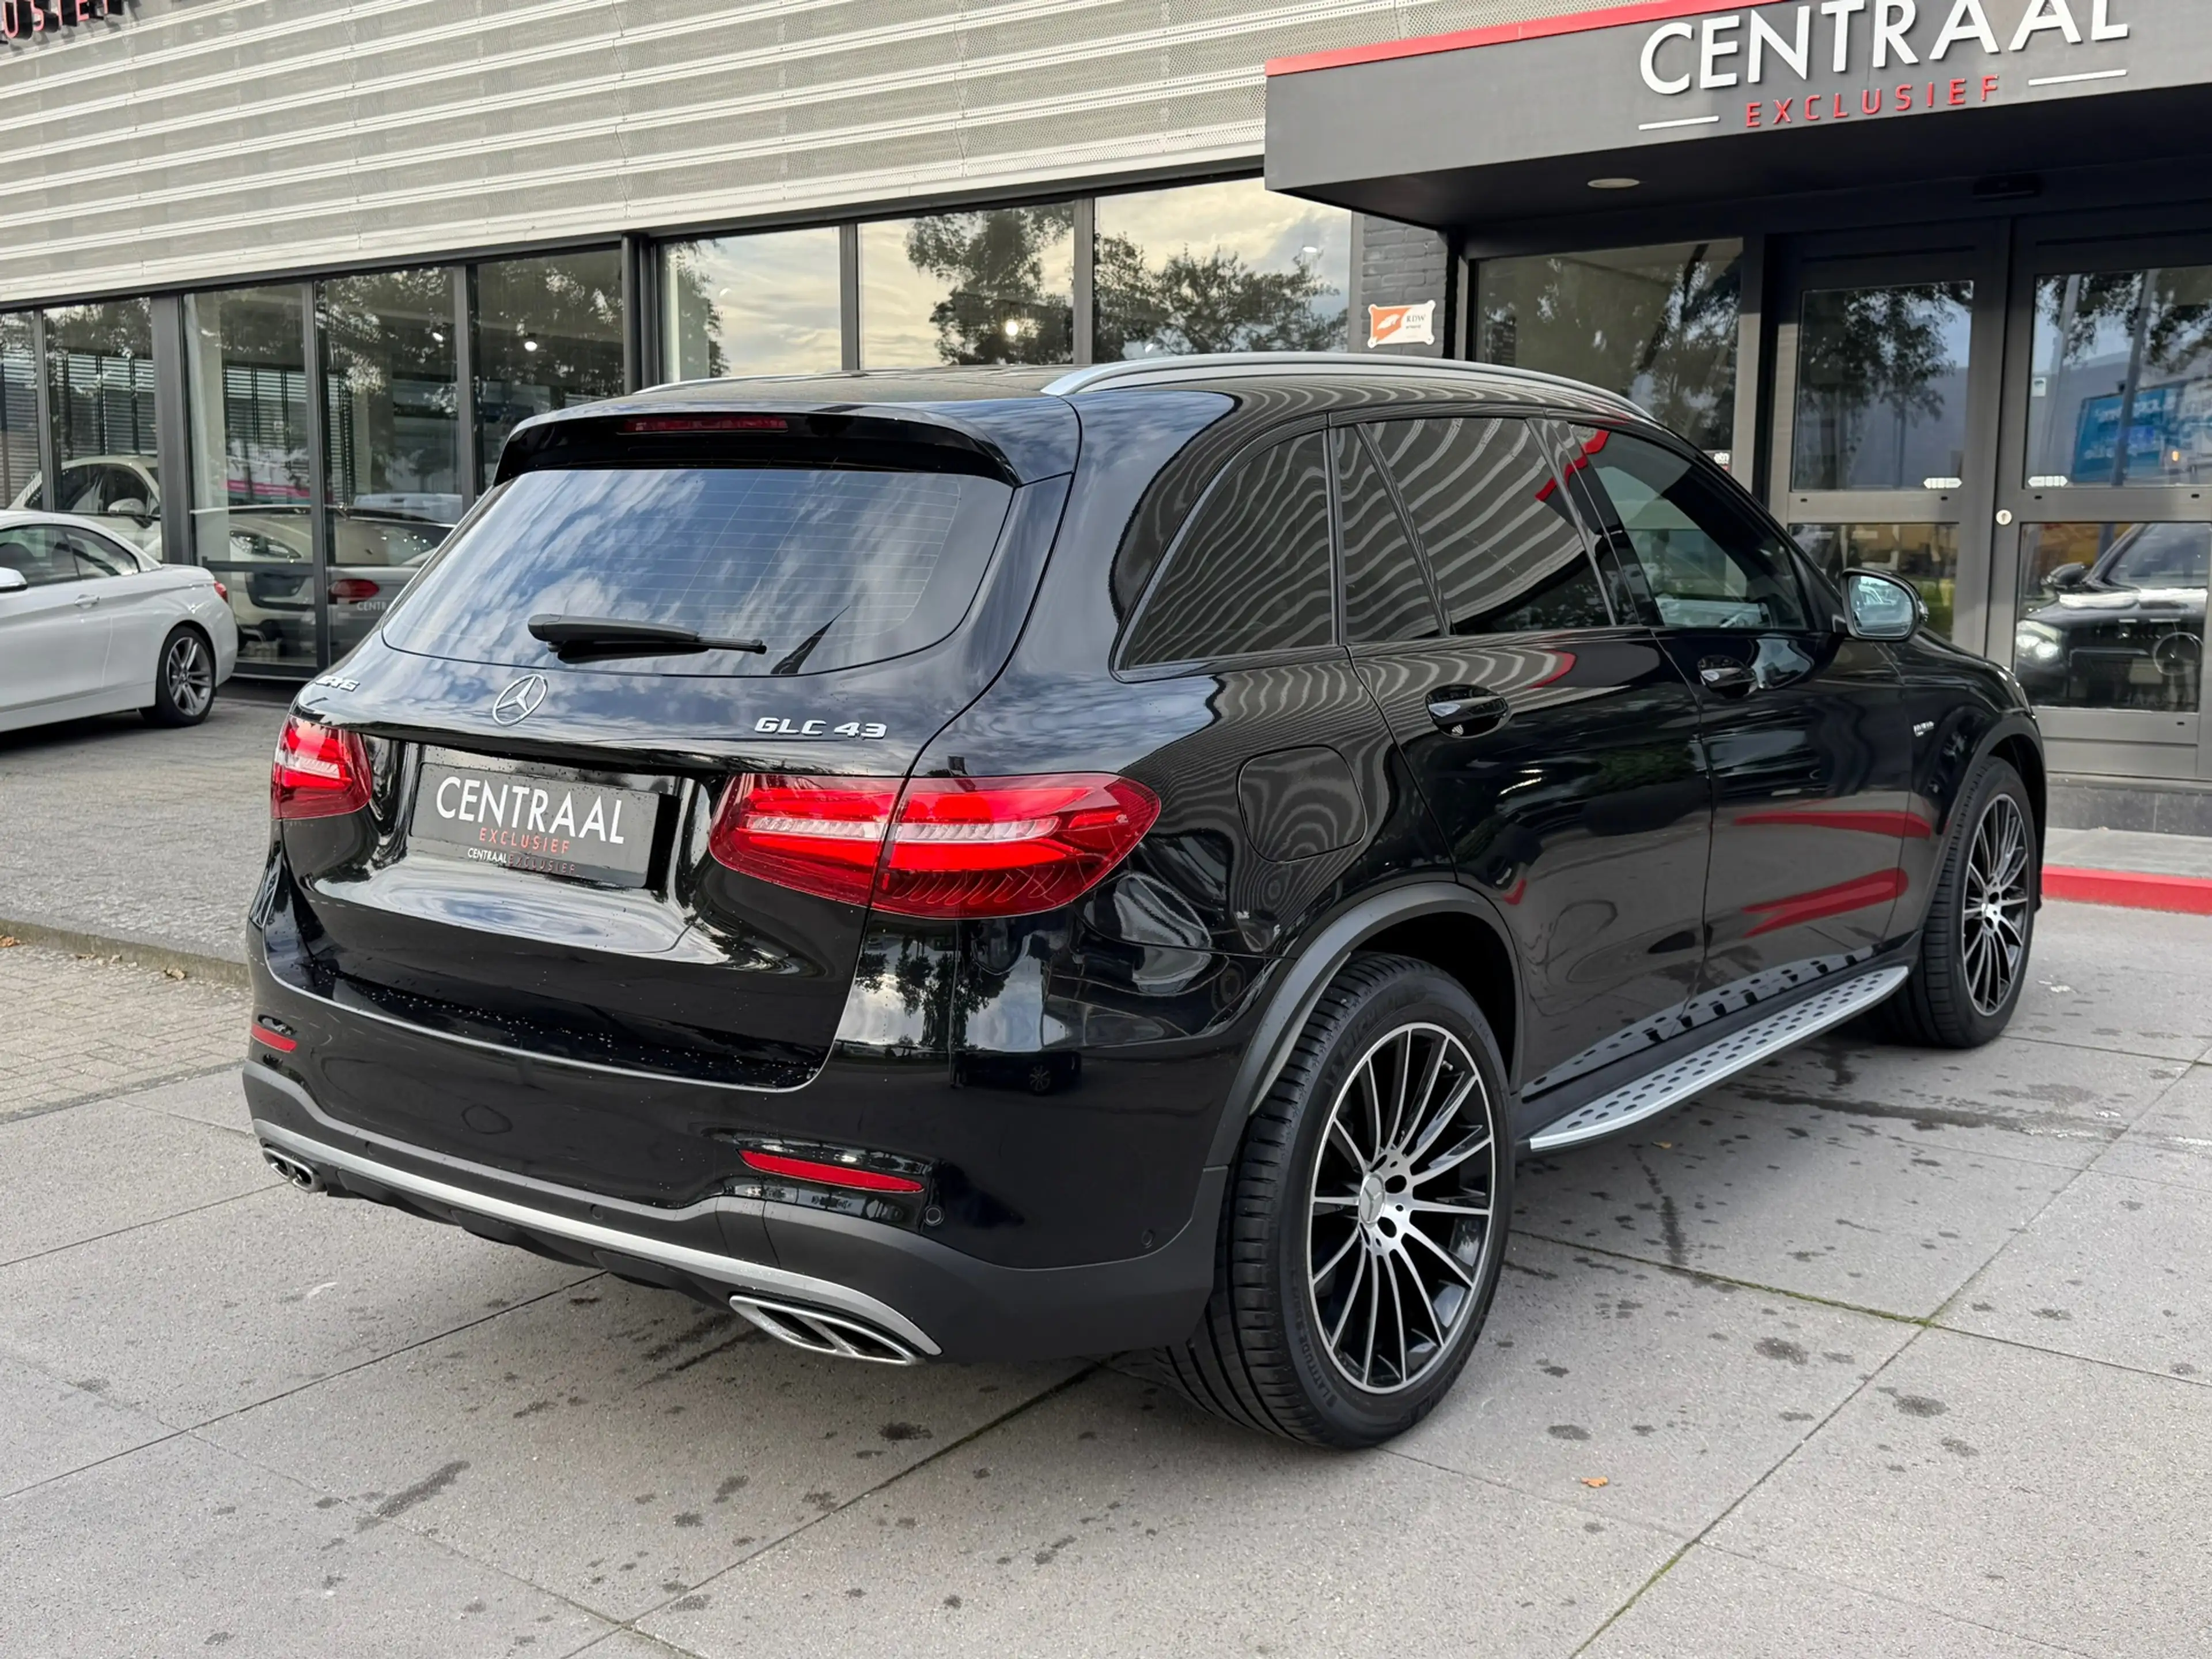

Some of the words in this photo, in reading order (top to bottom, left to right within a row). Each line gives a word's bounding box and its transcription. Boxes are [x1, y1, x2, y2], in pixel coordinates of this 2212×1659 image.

[1640, 0, 2130, 95] CENTRAAL
[1745, 75, 1998, 127] EXCLUSIEF
[755, 717, 827, 736] GLC
[834, 722, 887, 740] 43
[436, 776, 624, 844] CENTRAAL
[479, 827, 570, 854] EXCLUSIEF
[468, 847, 507, 864] CENTRAAL
[509, 852, 576, 874] EXCLUSIEF
